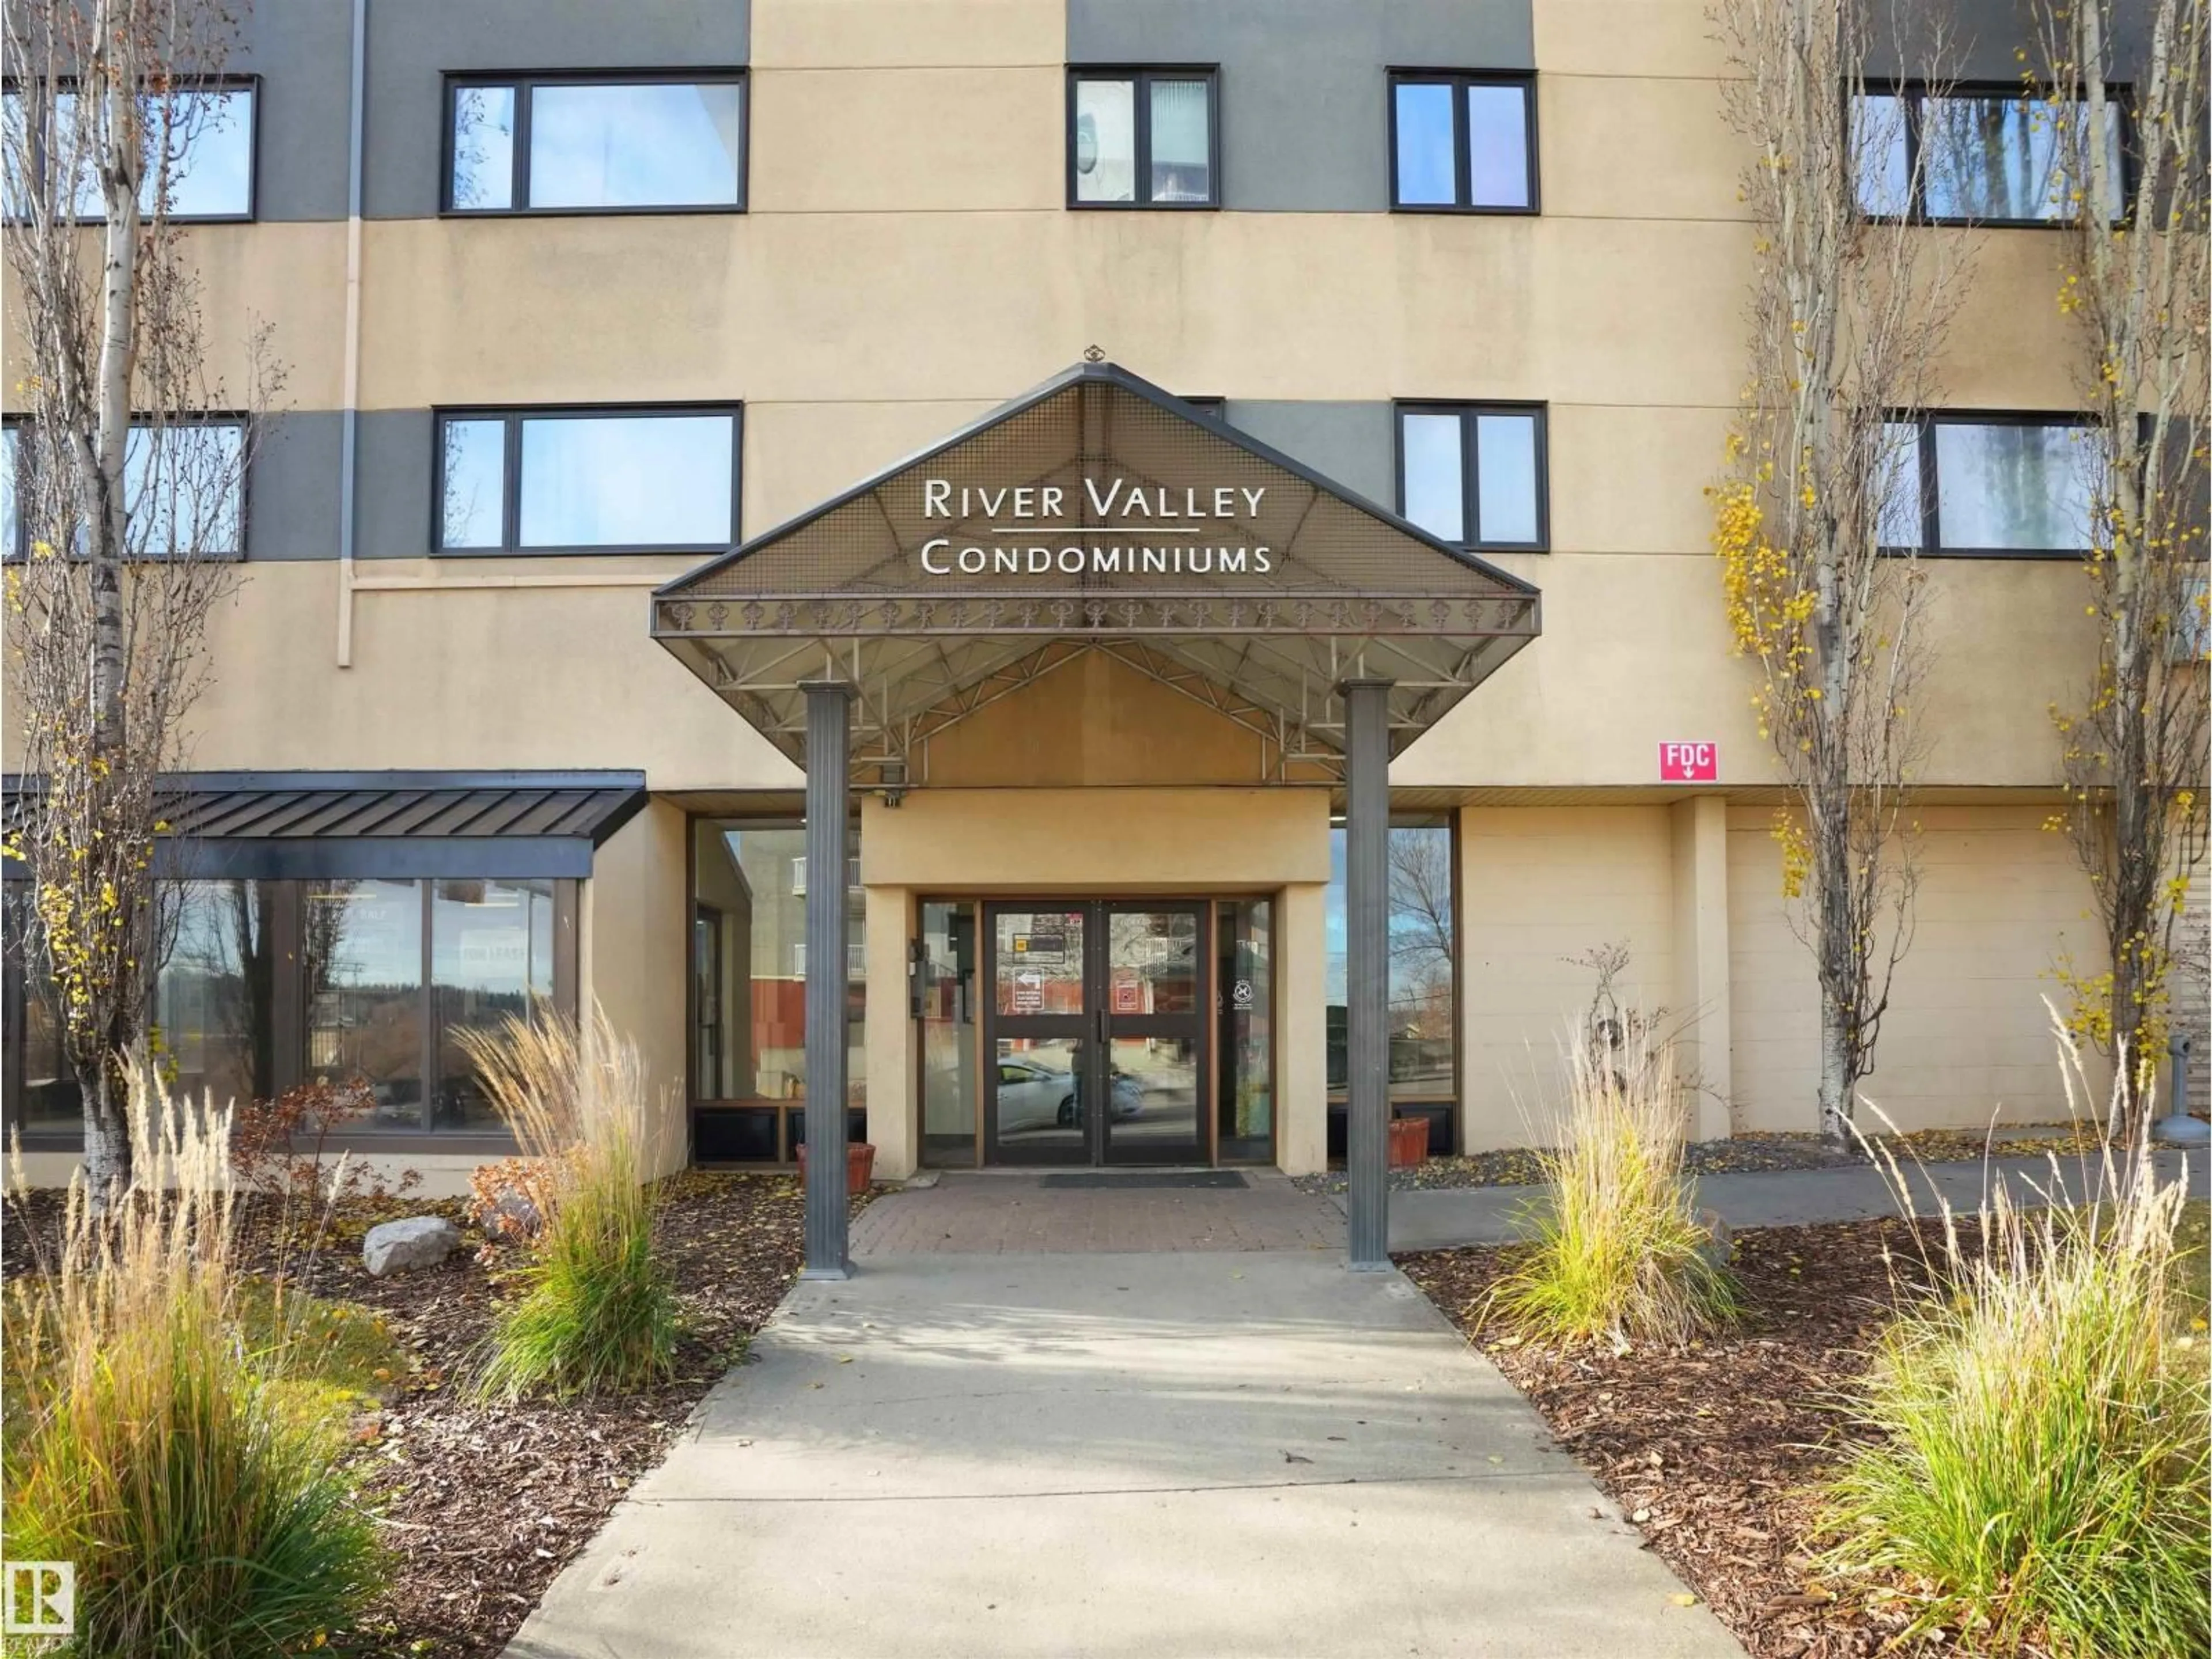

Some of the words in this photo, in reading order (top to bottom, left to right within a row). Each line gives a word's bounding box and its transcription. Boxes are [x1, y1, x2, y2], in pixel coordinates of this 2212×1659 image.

[924, 479, 1063, 518] RIVER
[1085, 479, 1266, 518] VALLEY
[921, 539, 1271, 574] CONDOMINIUMS
[1667, 744, 1710, 766] FDC
